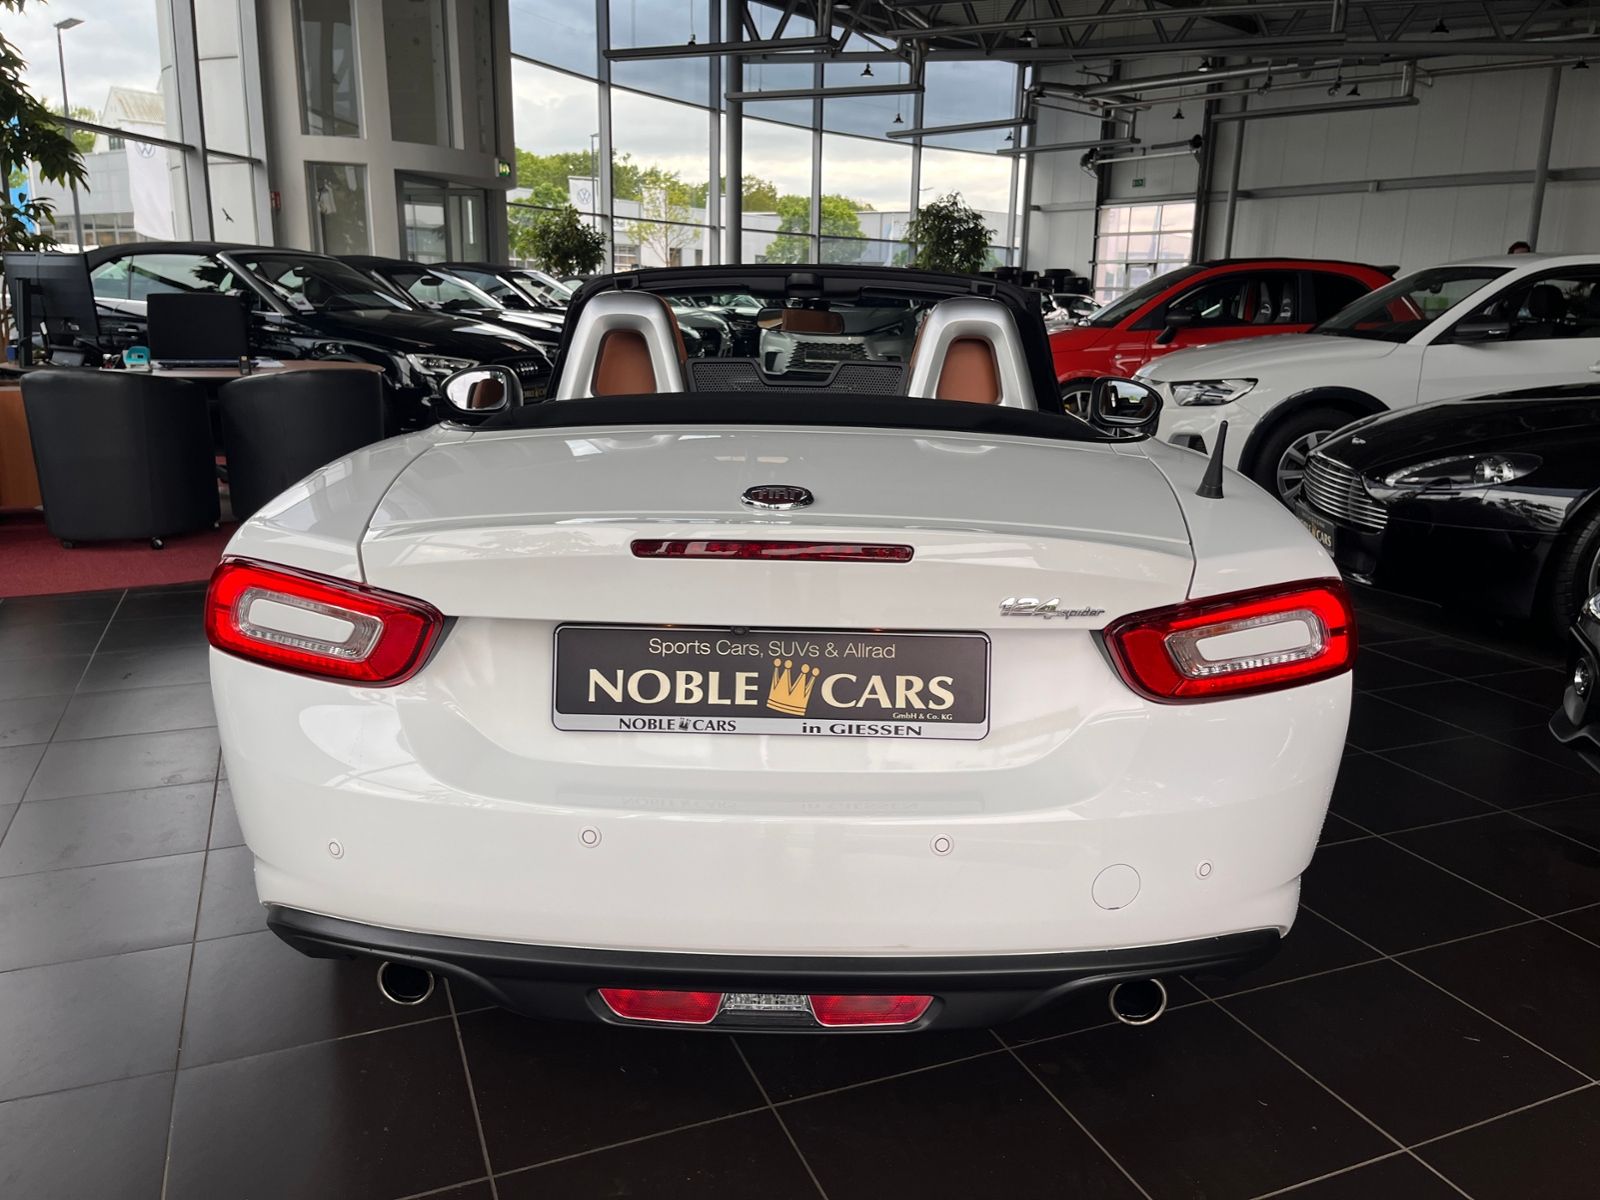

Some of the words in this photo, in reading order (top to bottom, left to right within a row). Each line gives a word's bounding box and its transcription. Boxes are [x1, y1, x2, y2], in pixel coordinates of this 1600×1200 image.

[1000, 597, 1060, 617] 124
[648, 637, 711, 657] Sports
[716, 639, 764, 658] Cars,
[768, 640, 820, 657] SUVs
[824, 642, 839, 658] &
[843, 642, 896, 658] Allrad
[588, 669, 758, 705] NOBLE
[821, 673, 955, 710] CARS
[892, 712, 917, 720] GmbH
[619, 718, 675, 730] NOBLE
[692, 719, 737, 732] CARS
[802, 722, 822, 734] in
[828, 723, 922, 736] GIESSEN
